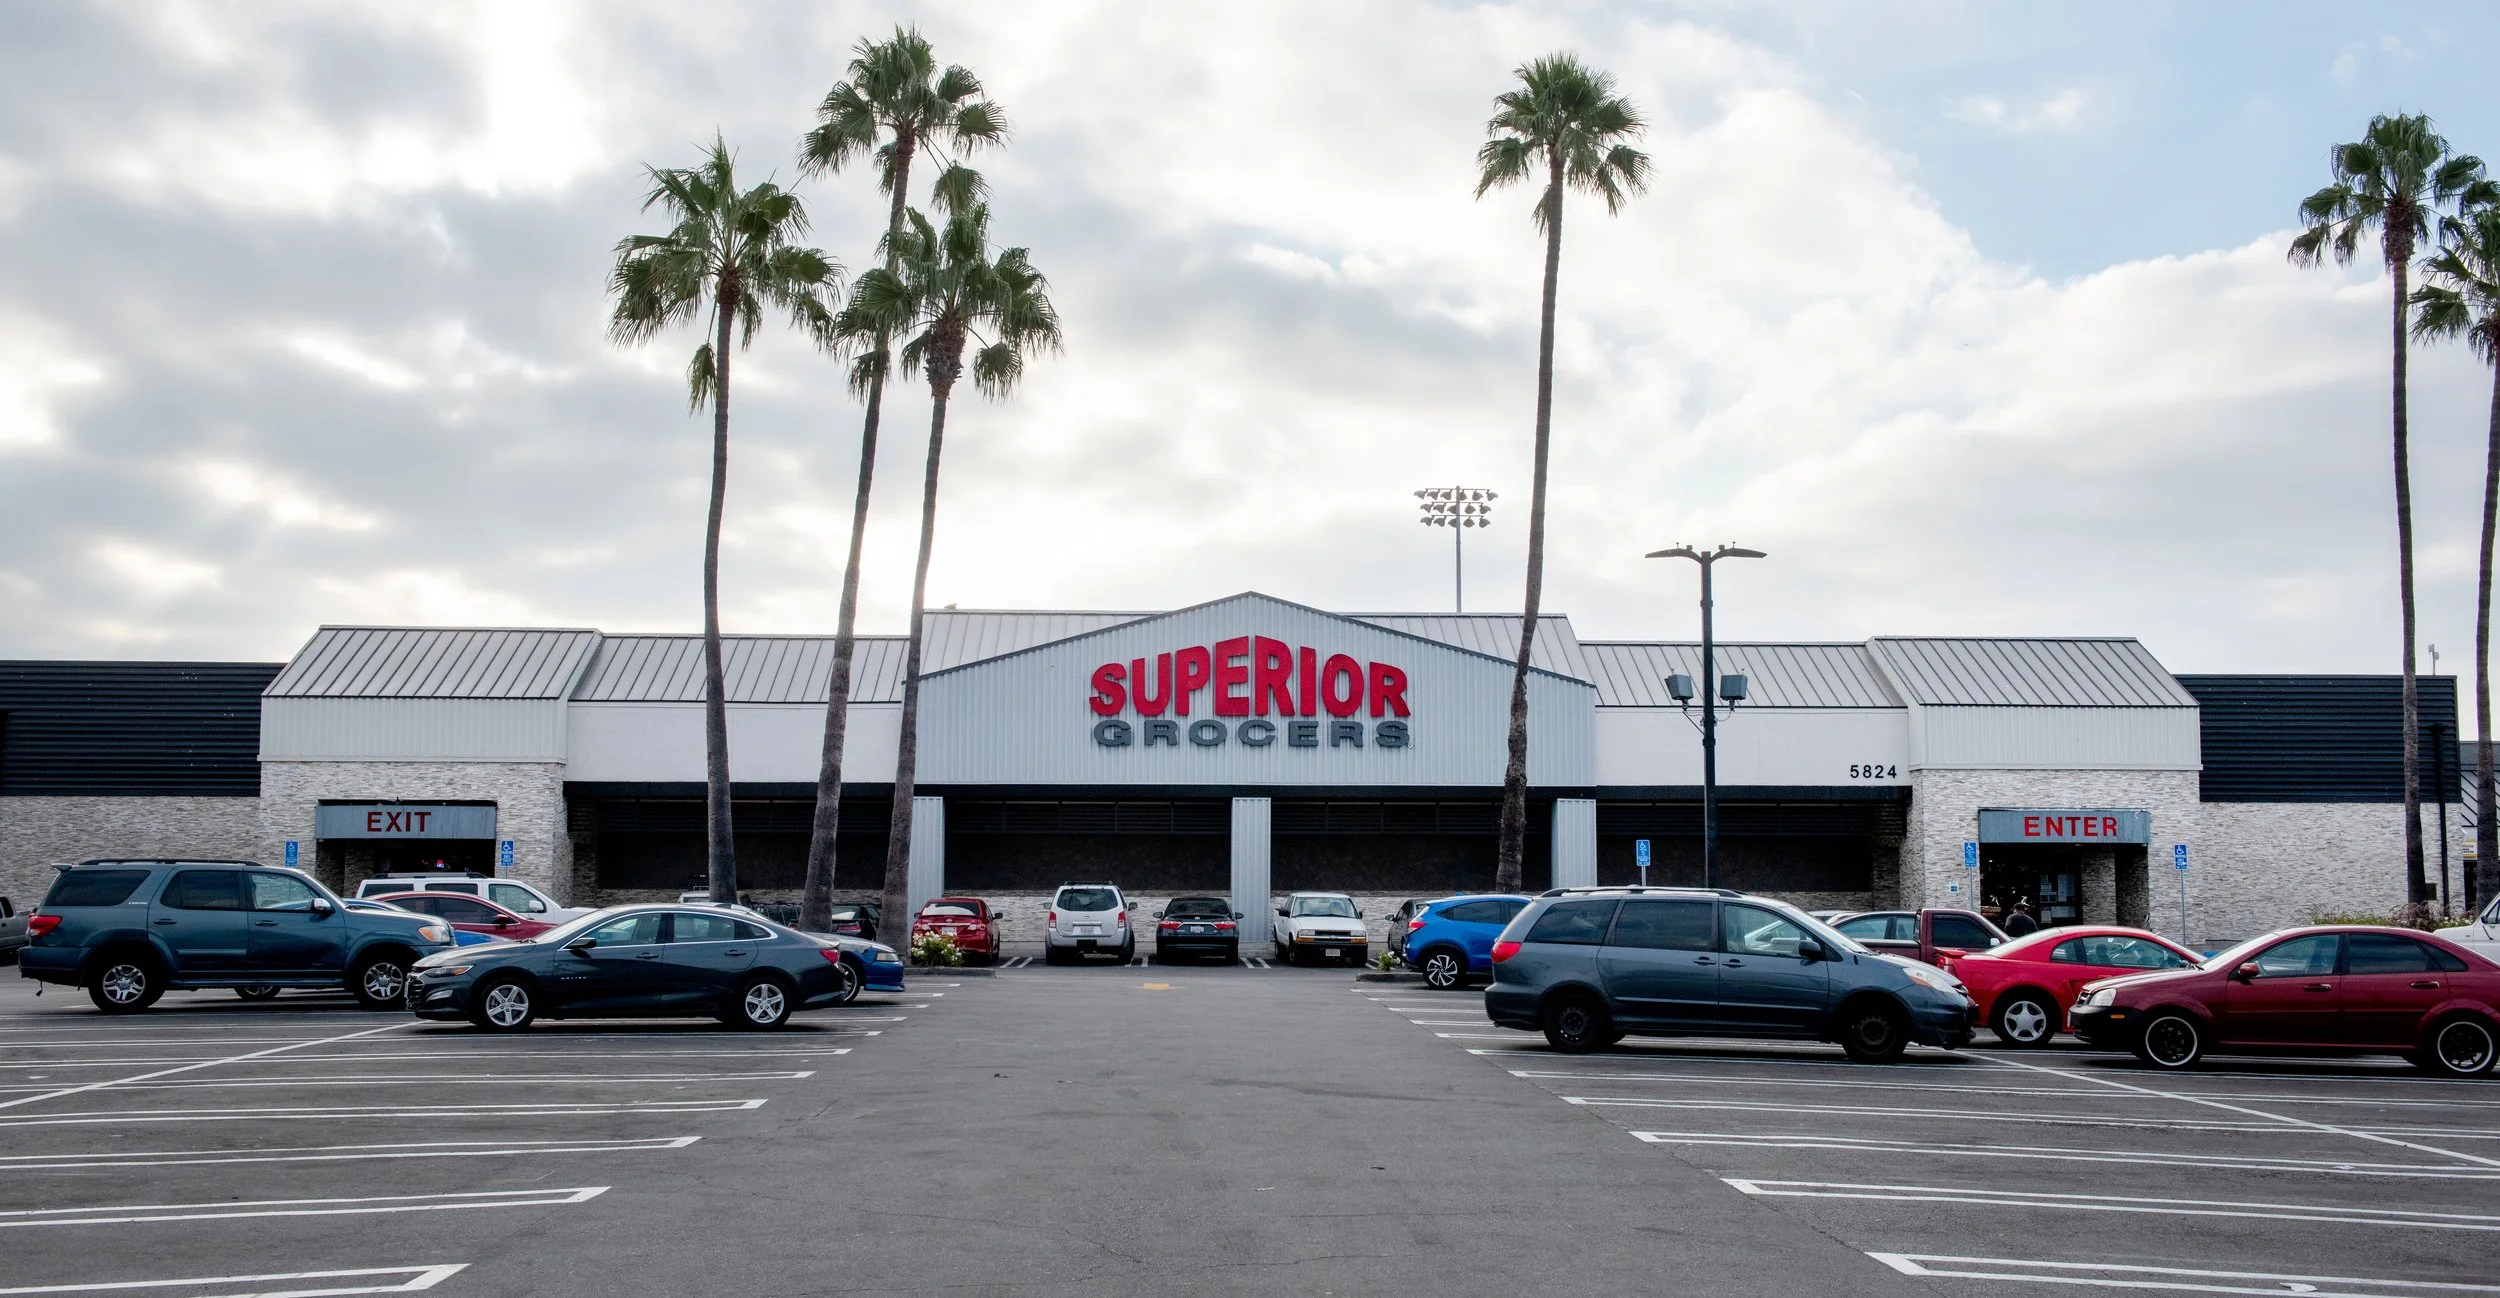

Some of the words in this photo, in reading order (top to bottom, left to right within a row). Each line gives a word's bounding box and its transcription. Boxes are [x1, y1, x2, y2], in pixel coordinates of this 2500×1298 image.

[1089, 635, 1411, 717] SUPERIOR
[1093, 720, 1410, 746] GROCERS
[1850, 764, 1897, 779] 5824
[367, 811, 432, 832] EXIT
[2024, 816, 2117, 837] ENTER
